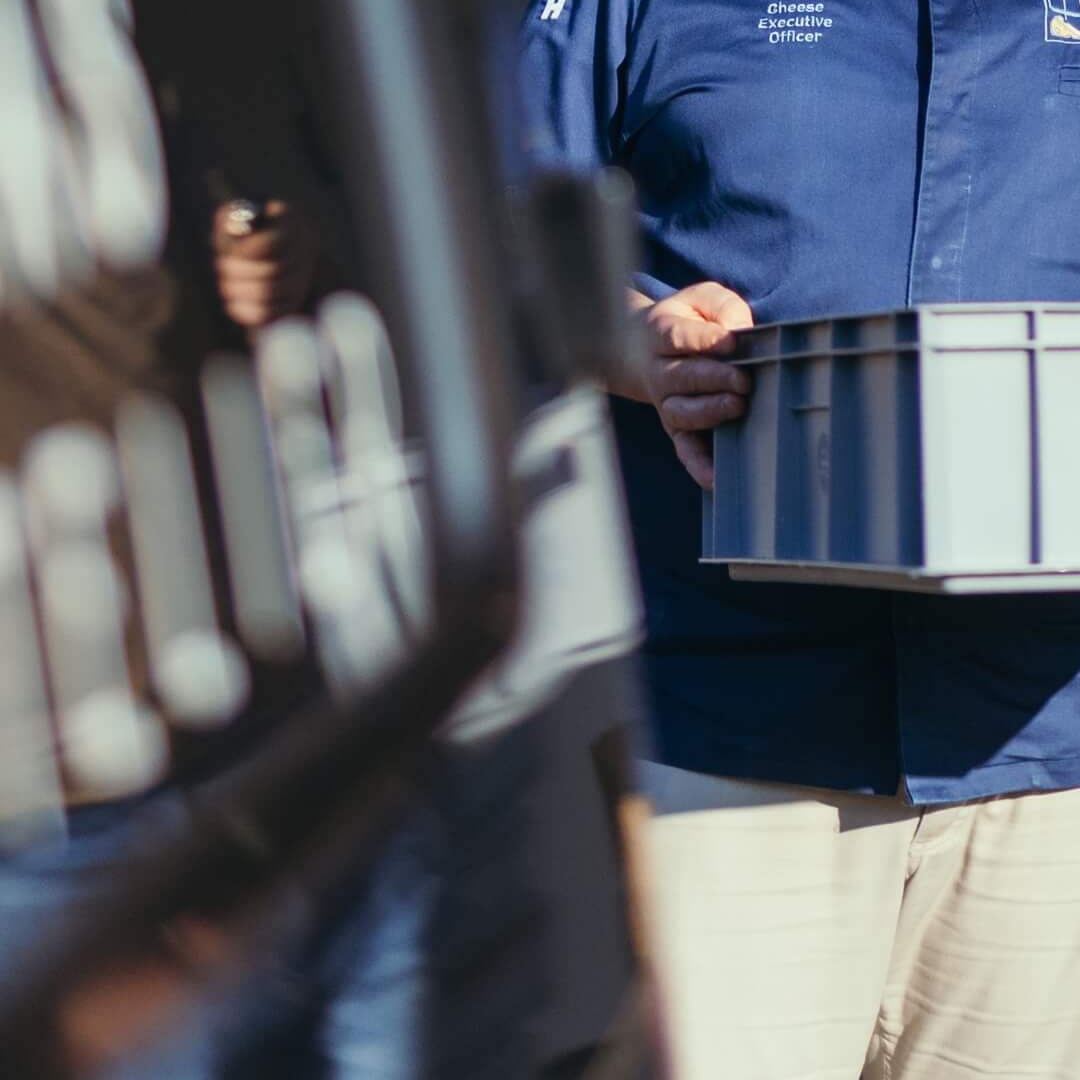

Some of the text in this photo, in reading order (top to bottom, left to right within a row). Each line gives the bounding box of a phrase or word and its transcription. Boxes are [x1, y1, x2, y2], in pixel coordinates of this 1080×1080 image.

[767, 1, 824, 14] Cheese
[758, 16, 833, 29] Executive
[769, 30, 823, 44] Officer
